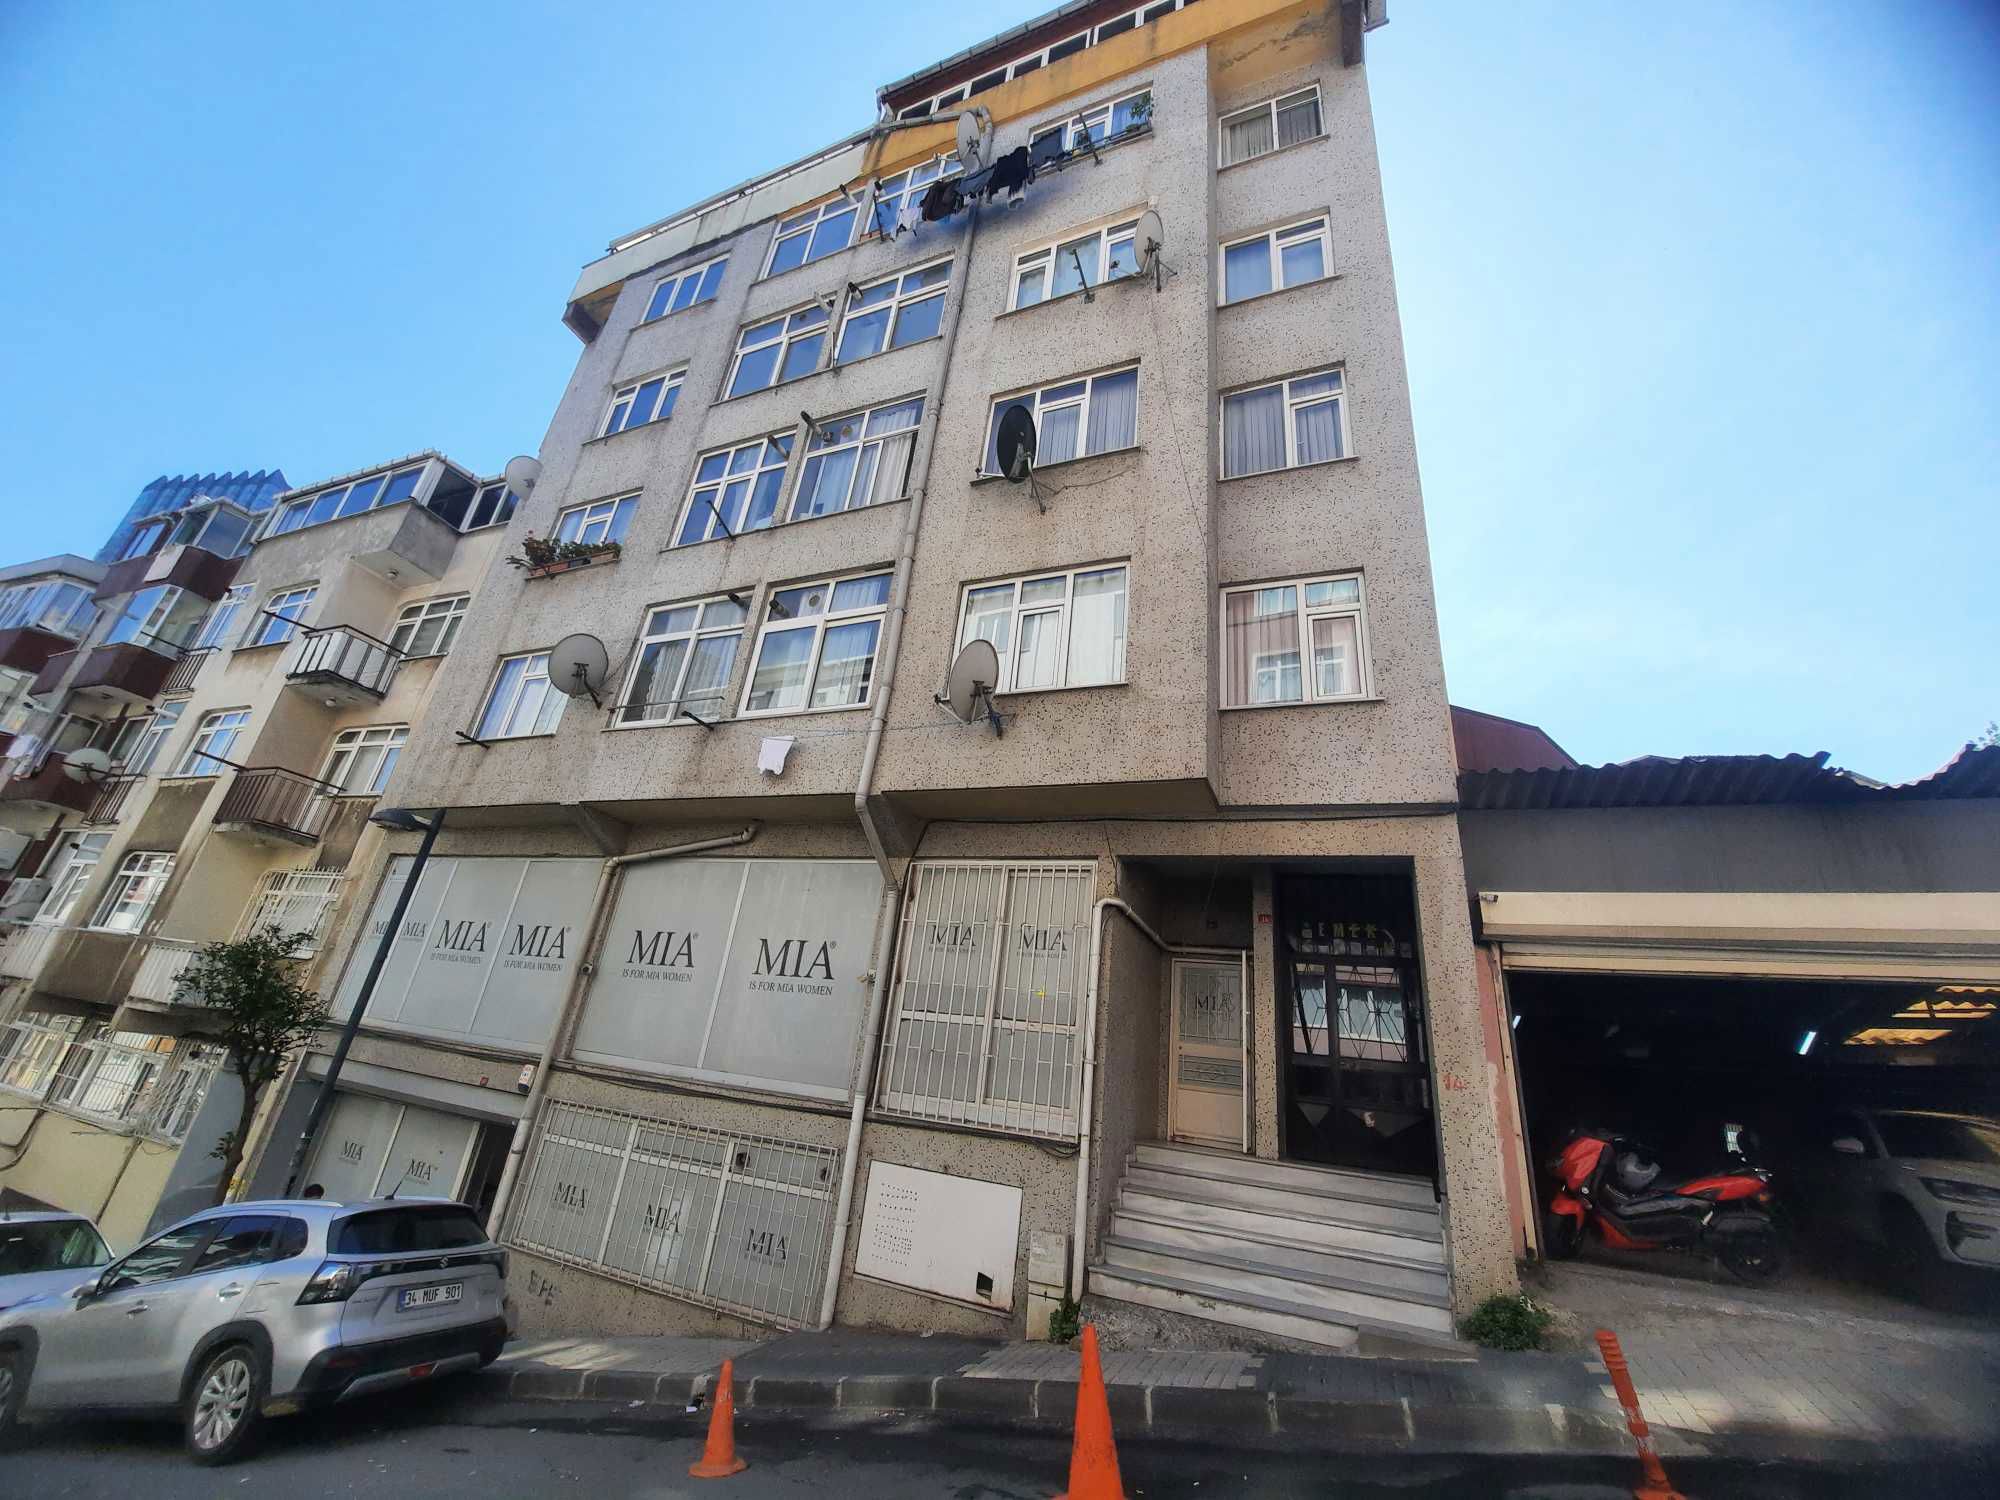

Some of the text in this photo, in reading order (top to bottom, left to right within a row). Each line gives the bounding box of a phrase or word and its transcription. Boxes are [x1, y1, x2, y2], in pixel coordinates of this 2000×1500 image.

[435, 919, 486, 952] MIA
[508, 924, 566, 959] MIA
[930, 925, 976, 947] MIA
[1018, 927, 1067, 951] MIA
[625, 929, 695, 968] MIA
[751, 938, 835, 980] MIA
[630, 969, 645, 979] FOR
[662, 972, 694, 983] WOMEN
[757, 981, 775, 992] FOR
[776, 983, 795, 993] MIA
[797, 984, 833, 996] WOMEN
[406, 1159, 432, 1181] MIA
[746, 1229, 787, 1260] MIA
[405, 1291, 418, 1306] 34
[444, 1285, 462, 1299] 901
